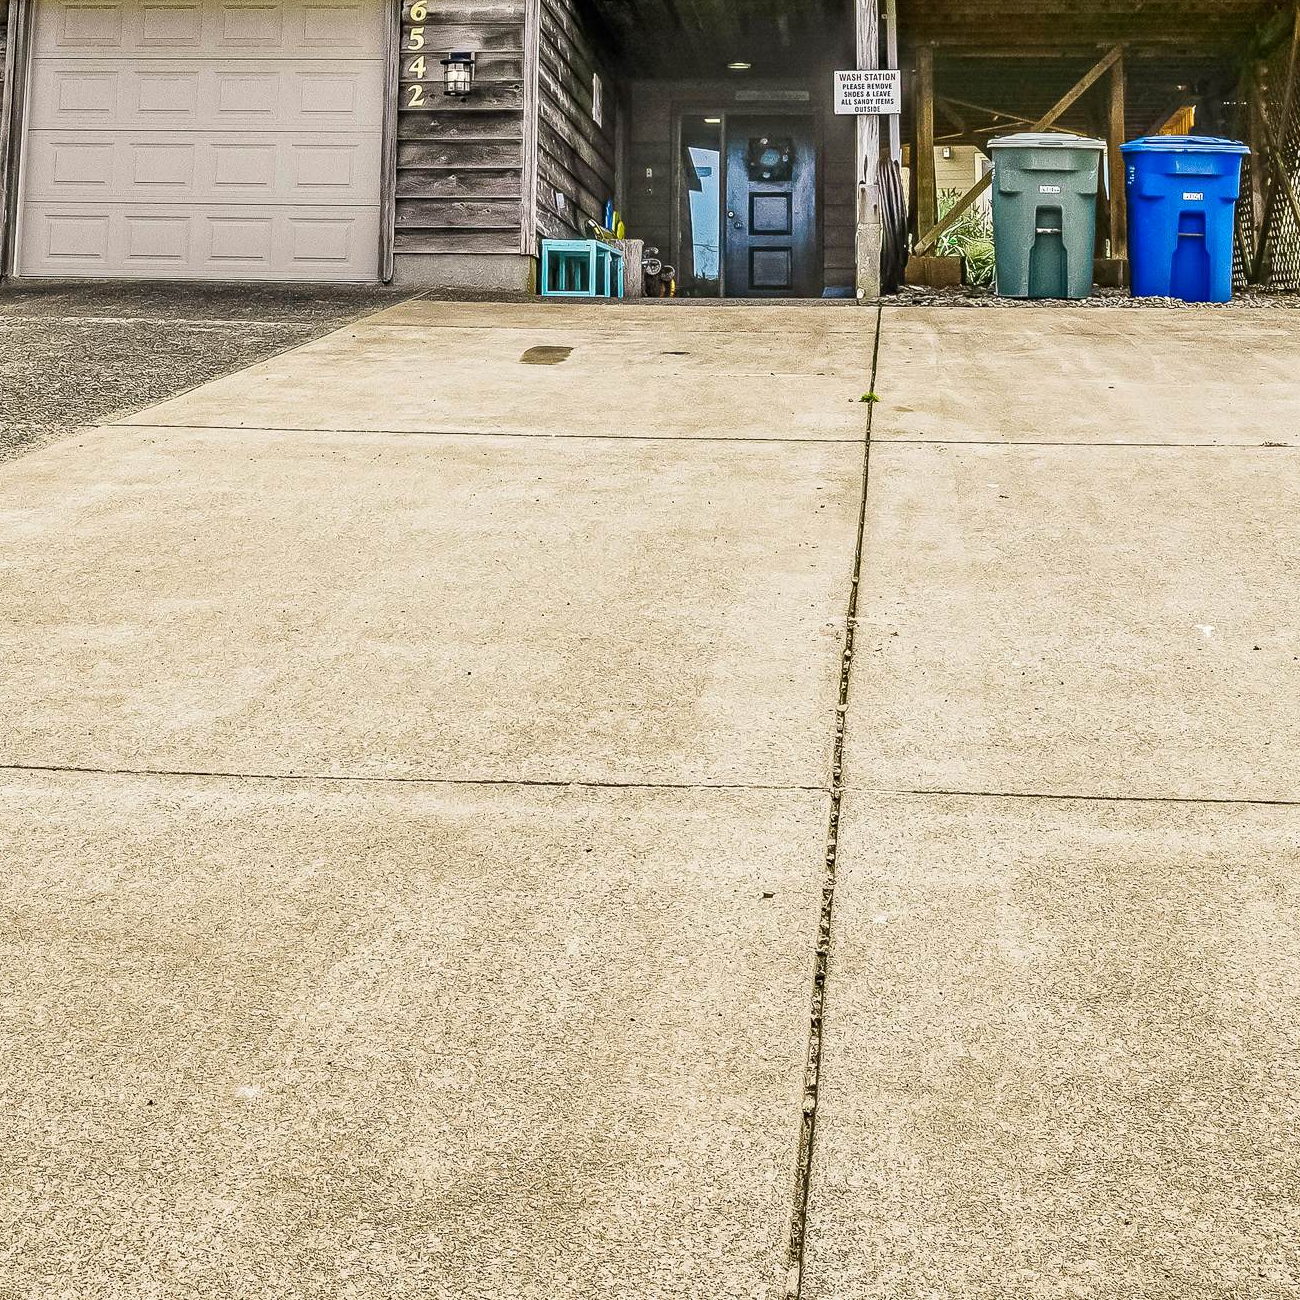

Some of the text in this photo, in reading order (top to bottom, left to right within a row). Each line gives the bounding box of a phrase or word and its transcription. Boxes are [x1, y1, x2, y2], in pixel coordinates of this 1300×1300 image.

[407, 0, 428, 107] 6542
[839, 73, 896, 81] WASH STATION
